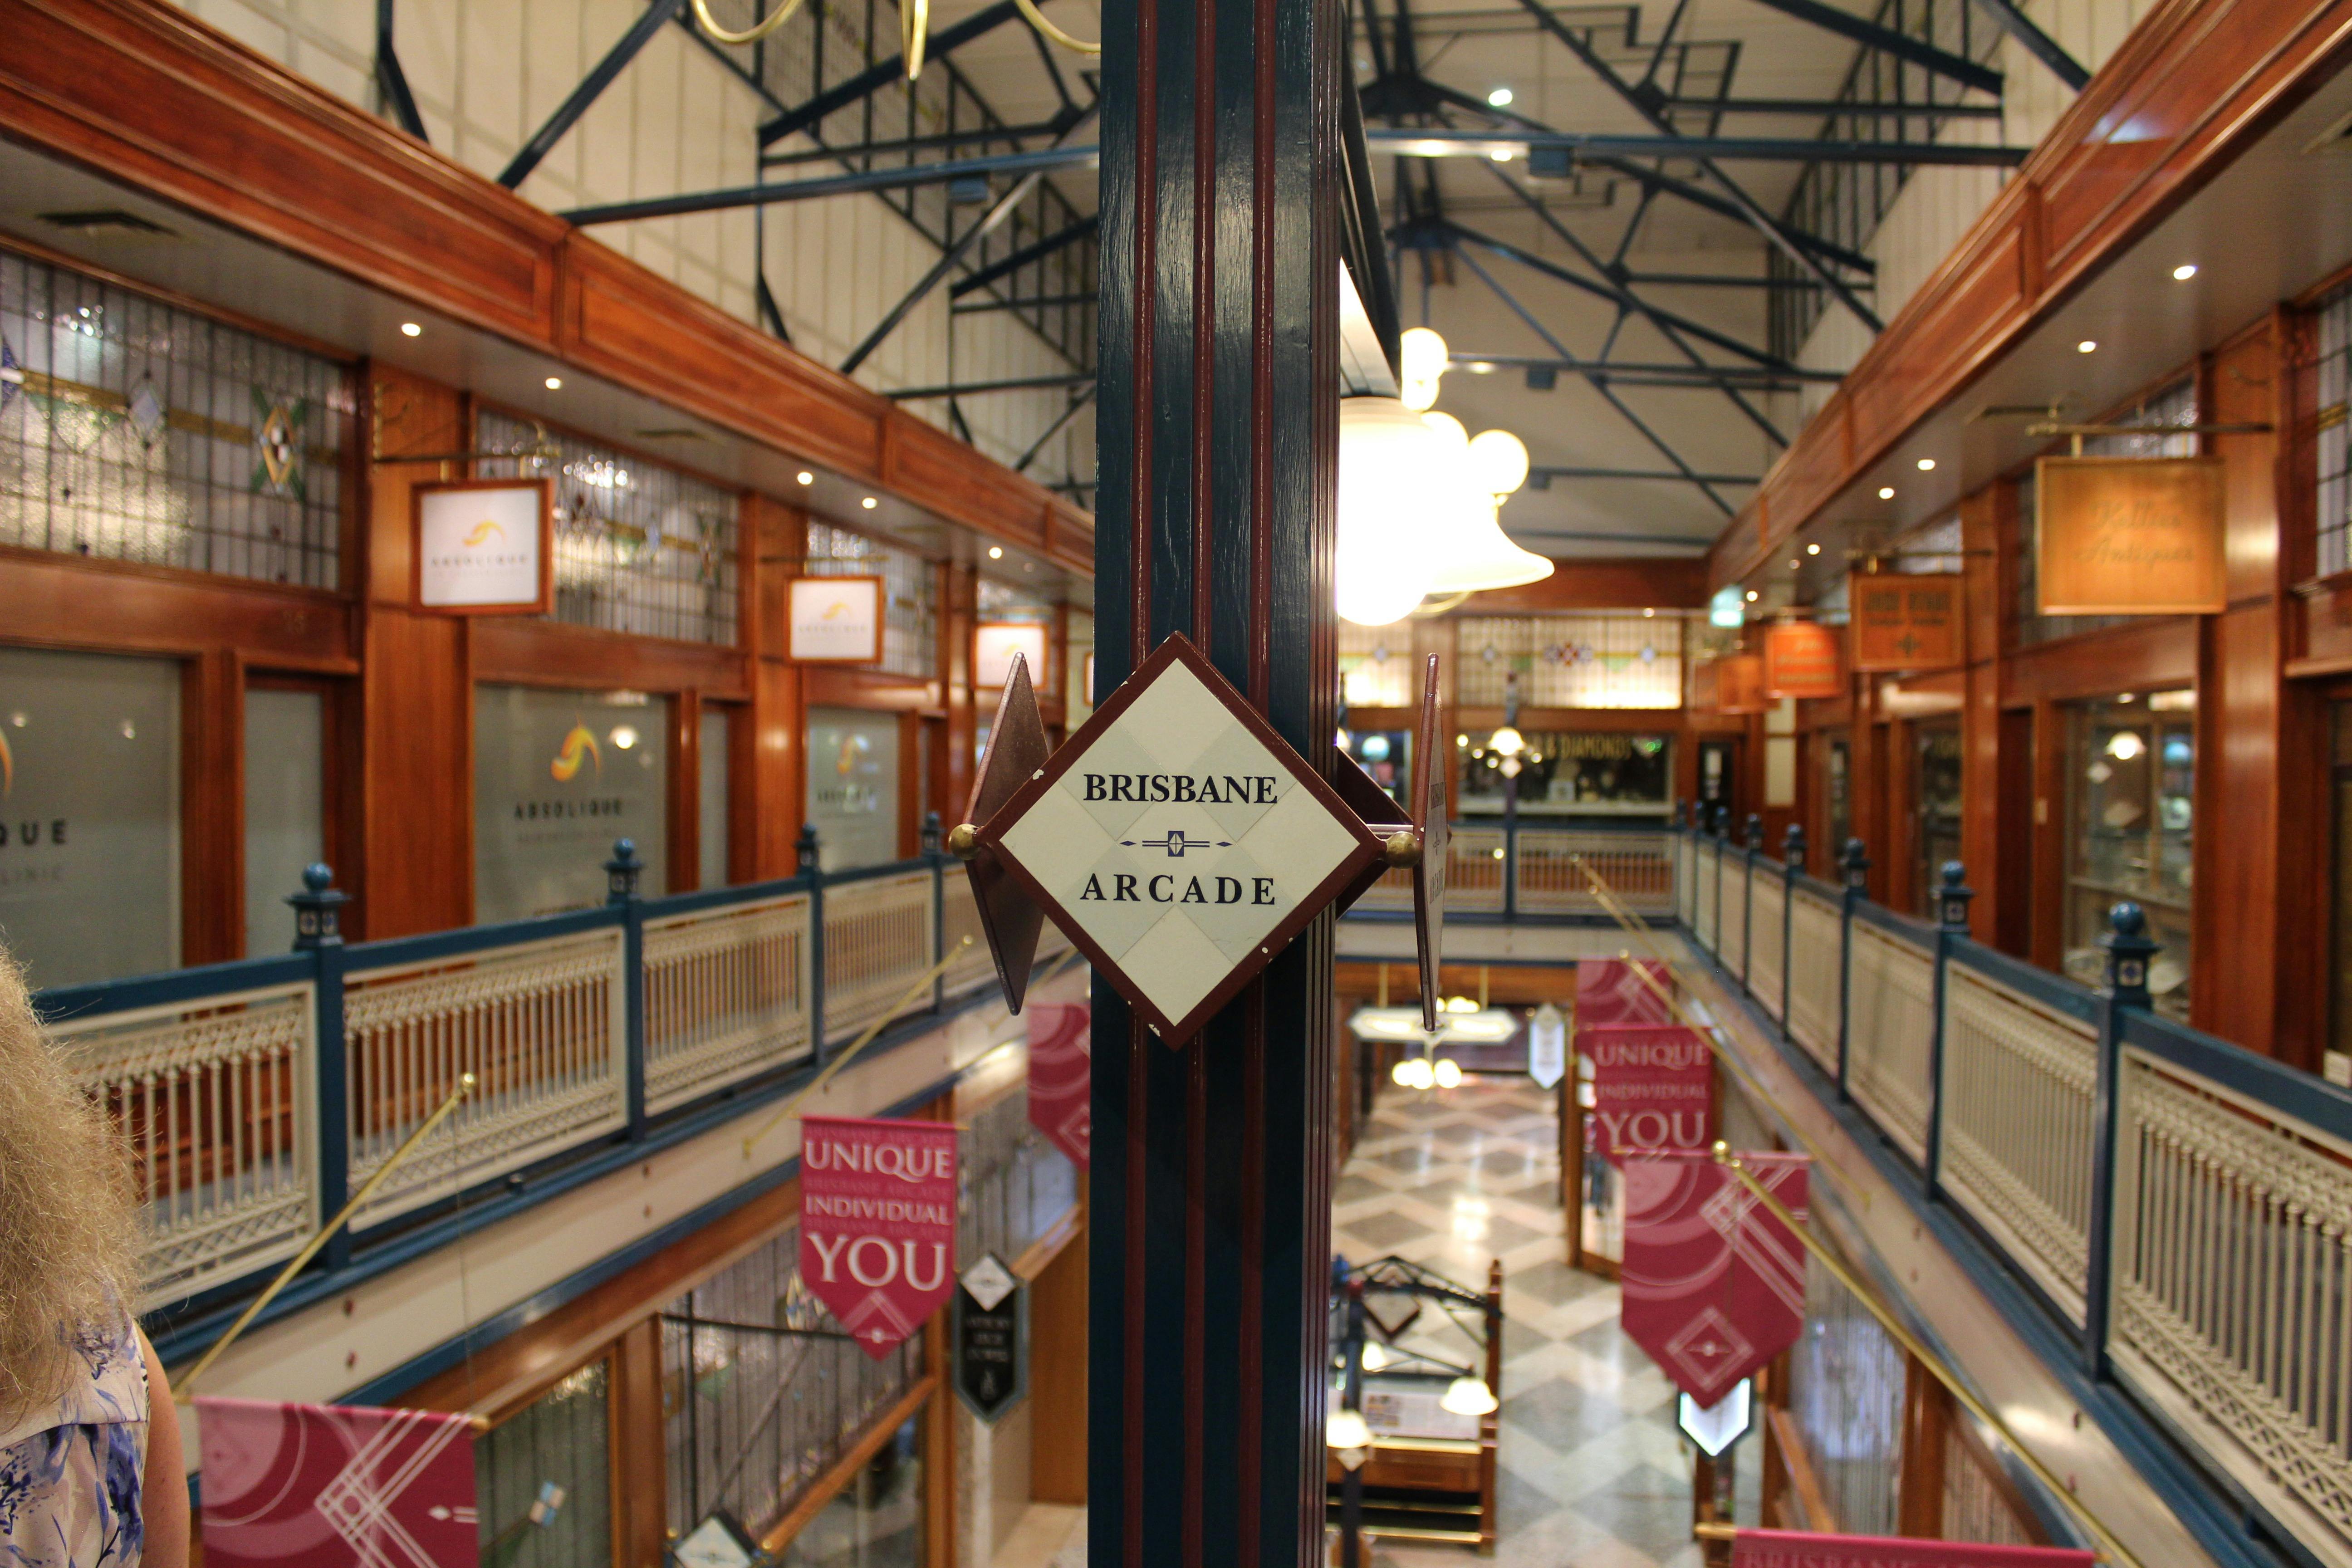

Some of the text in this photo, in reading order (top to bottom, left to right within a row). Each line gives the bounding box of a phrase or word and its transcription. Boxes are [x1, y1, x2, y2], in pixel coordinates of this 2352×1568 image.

[1083, 774, 1278, 804] BRISBANE
[1080, 873, 1275, 906] ARCADE
[1595, 1042, 1709, 1071] UNIQUE
[1598, 1108, 1705, 1149] YOU
[805, 1140, 952, 1183] UNIQUE
[805, 1194, 951, 1225] INDIVIDUAL
[807, 1231, 947, 1292] YOU
